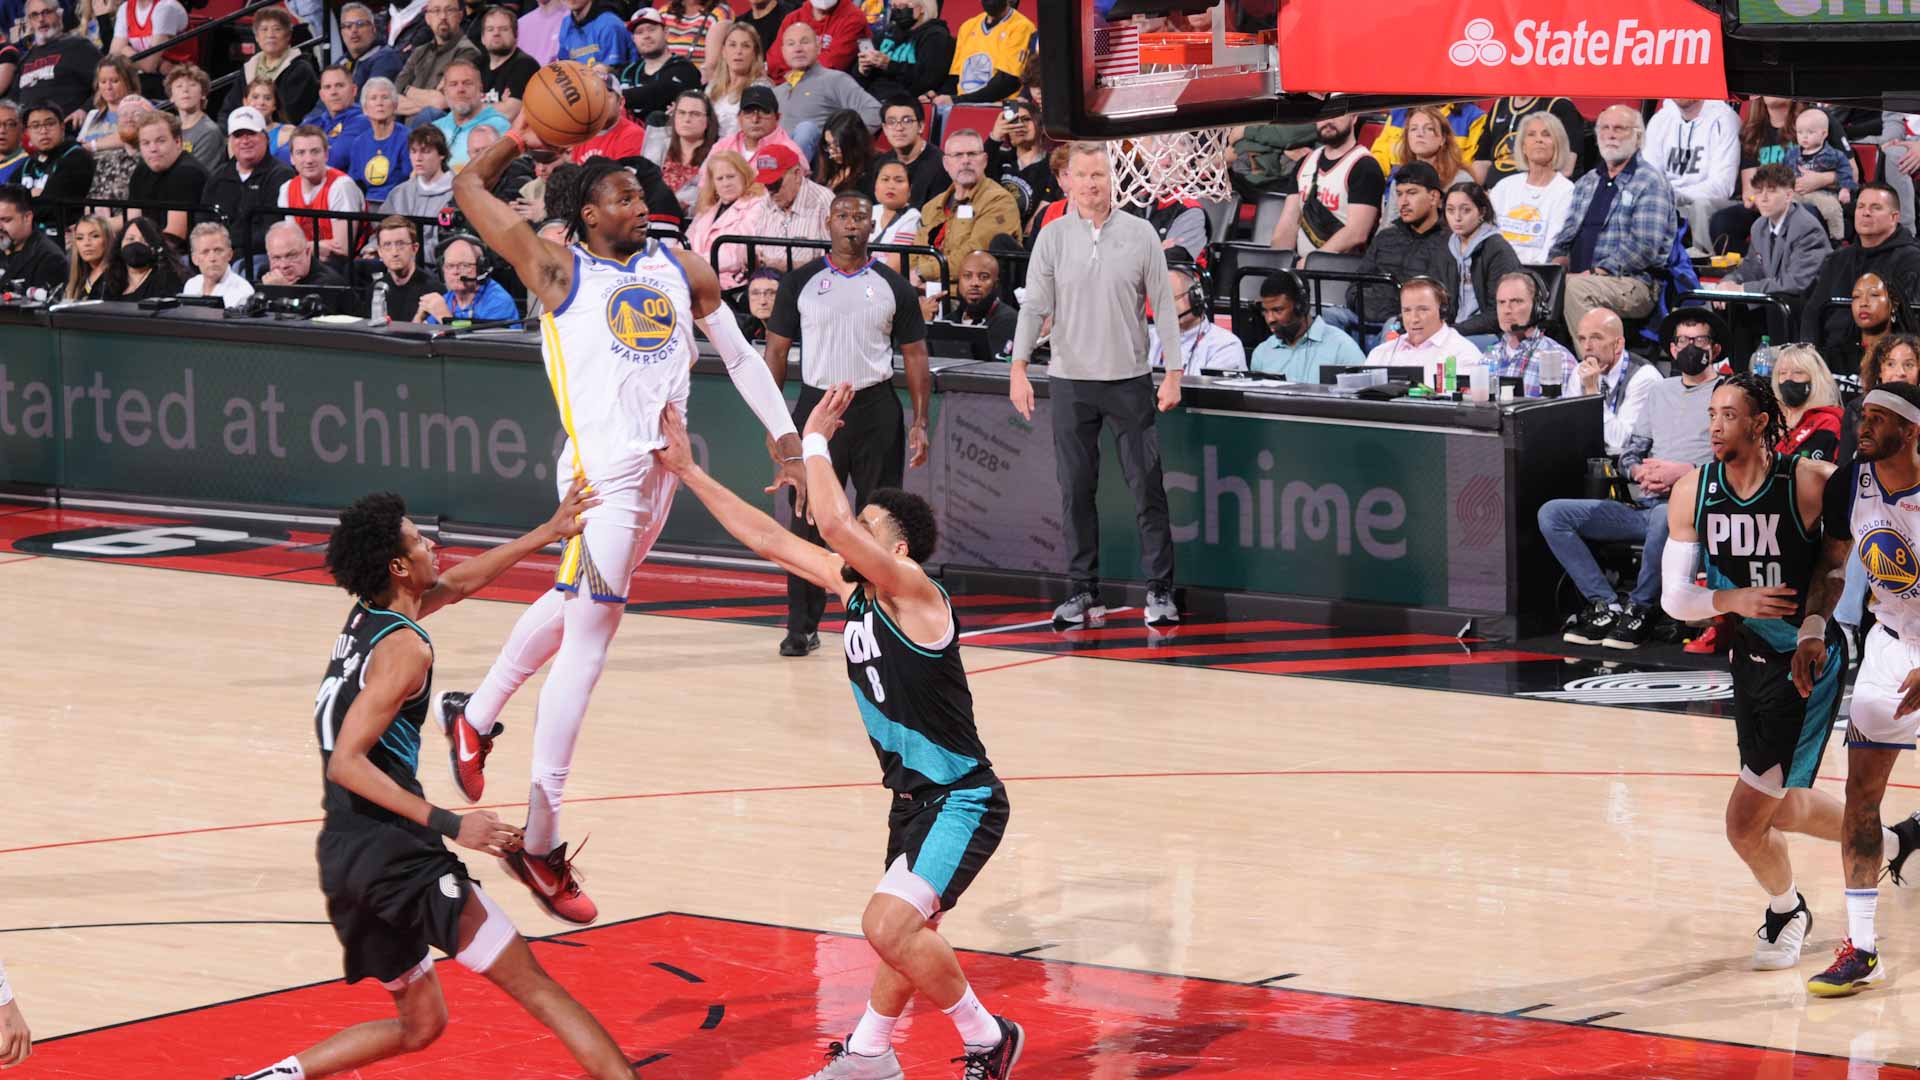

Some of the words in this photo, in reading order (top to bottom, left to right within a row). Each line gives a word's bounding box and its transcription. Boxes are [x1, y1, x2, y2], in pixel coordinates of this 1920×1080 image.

[548, 63, 581, 106] Wilson
[643, 298, 670, 318] 00
[609, 336, 679, 365] WARRIORS
[0, 362, 197, 450] tarted
[223, 384, 287, 459] at
[1707, 481, 1718, 494] 6
[1861, 472, 1872, 488] 6
[1163, 444, 1407, 561] chime
[1706, 513, 1782, 556] PDX
[1858, 519, 1893, 537] GOLDEN
[1895, 547, 1907, 566] 8
[1748, 560, 1782, 588] 50
[865, 665, 886, 703] 8
